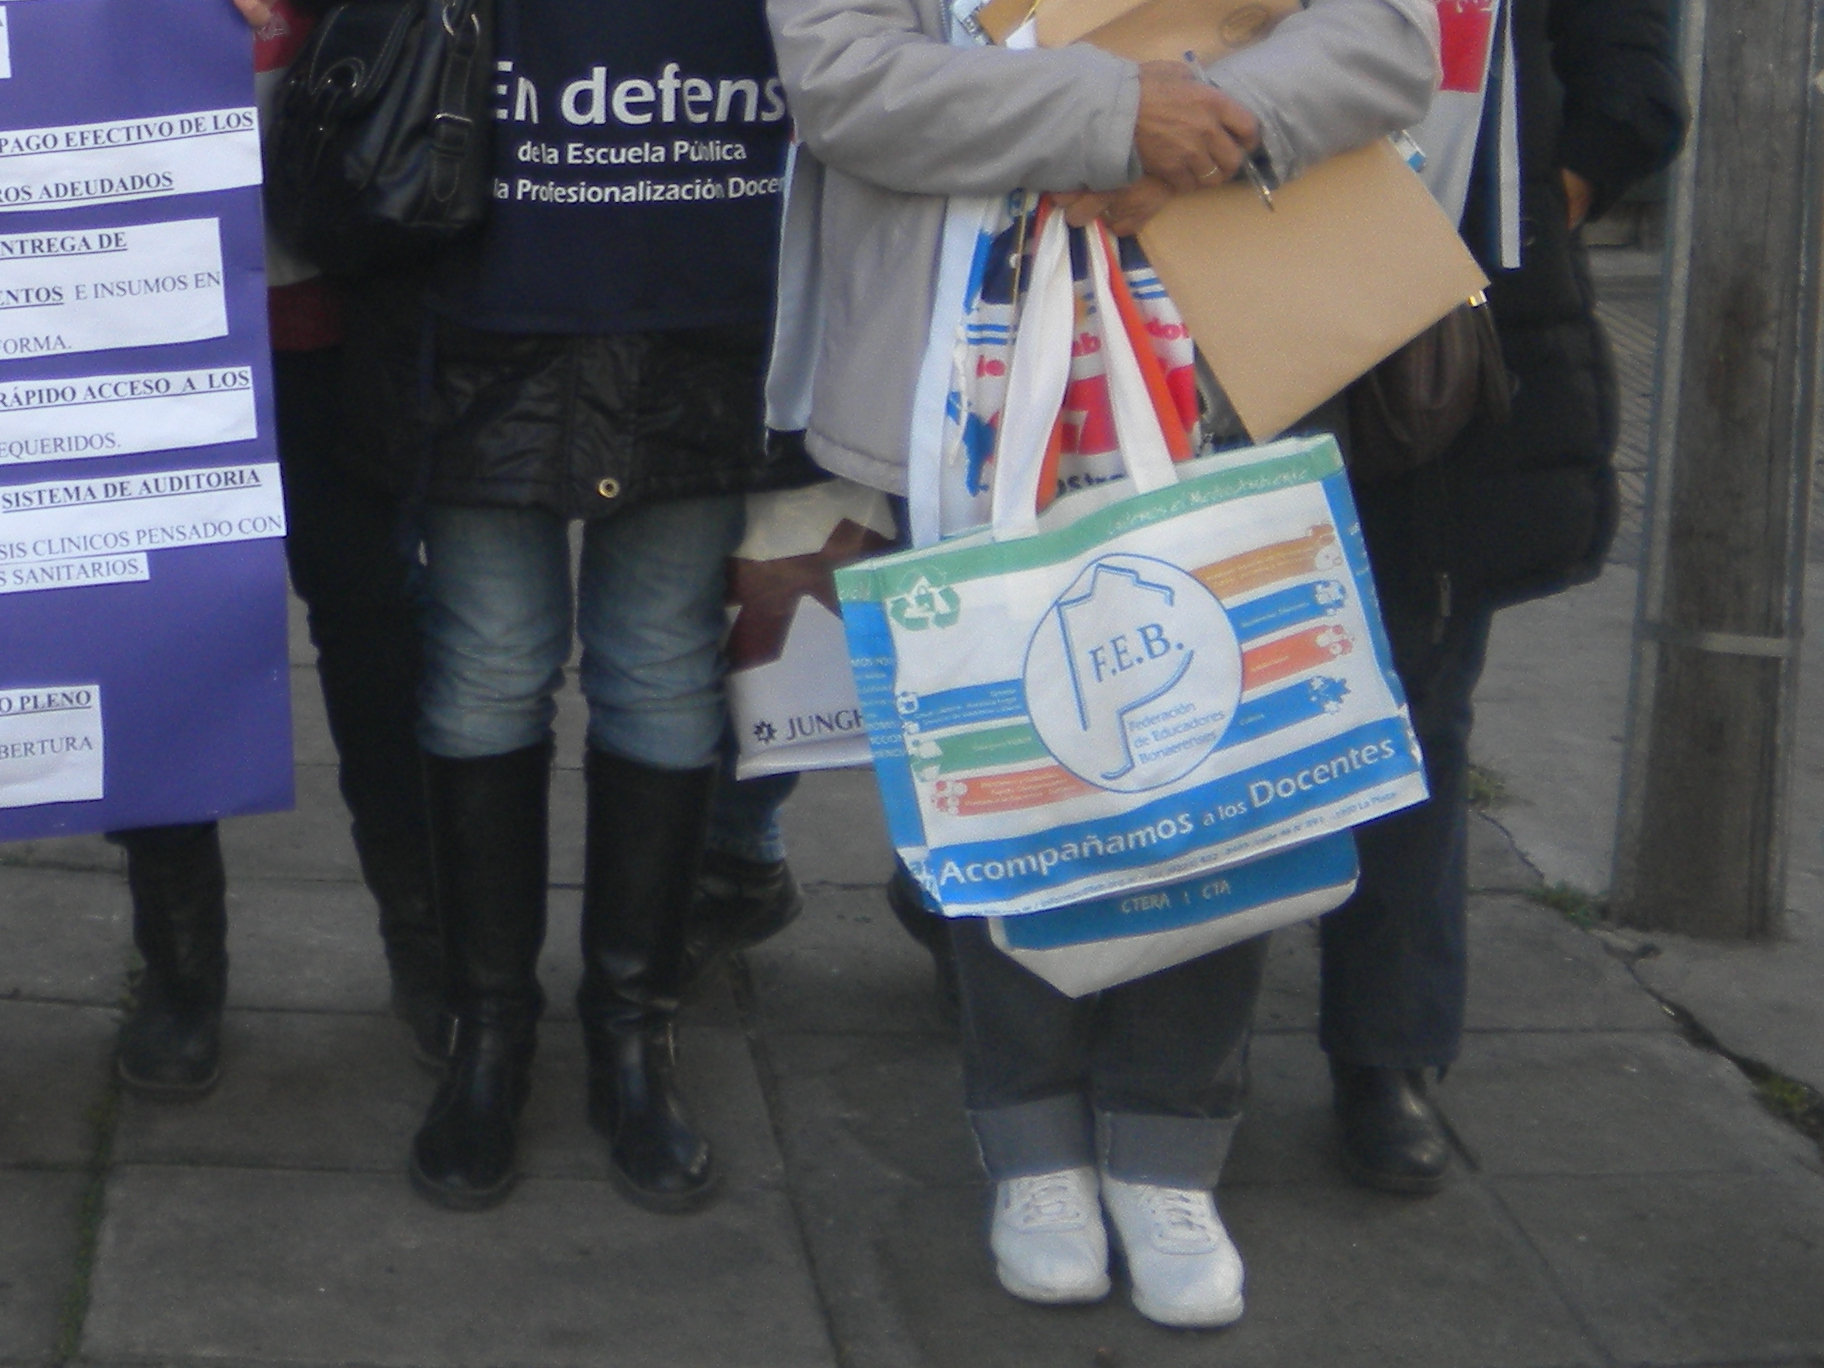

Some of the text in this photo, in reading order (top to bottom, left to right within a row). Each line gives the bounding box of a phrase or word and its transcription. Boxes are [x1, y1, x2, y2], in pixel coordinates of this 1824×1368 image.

[64, 121, 174, 148] EFECTIVO
[179, 115, 208, 134] DE
[212, 110, 255, 132] LOS
[566, 141, 667, 166] Escuela
[38, 170, 174, 200] ADEUDADOS
[515, 177, 726, 204] Profesionalización
[98, 231, 128, 250] DE
[74, 283, 87, 301] E
[92, 274, 189, 299] INSUMOS
[194, 271, 222, 290] EN
[82, 378, 171, 402] ACCESO
[181, 377, 198, 392] A
[207, 369, 251, 390] LOS
[1, 485, 98, 512] SISTEMA
[103, 481, 133, 500] DE
[137, 467, 262, 498] AUDITORIA
[32, 530, 131, 558] CLINICOS
[135, 520, 234, 548] PENSADO
[238, 514, 284, 535] CON
[12, 557, 145, 587] SANITARIOS.
[1087, 622, 1185, 684] F.E.B.
[19, 688, 92, 712] PLENO
[939, 812, 1195, 887] Acompañamos
[1202, 810, 1216, 828] a
[1217, 800, 1248, 821] los
[1248, 737, 1397, 810] Docentes
